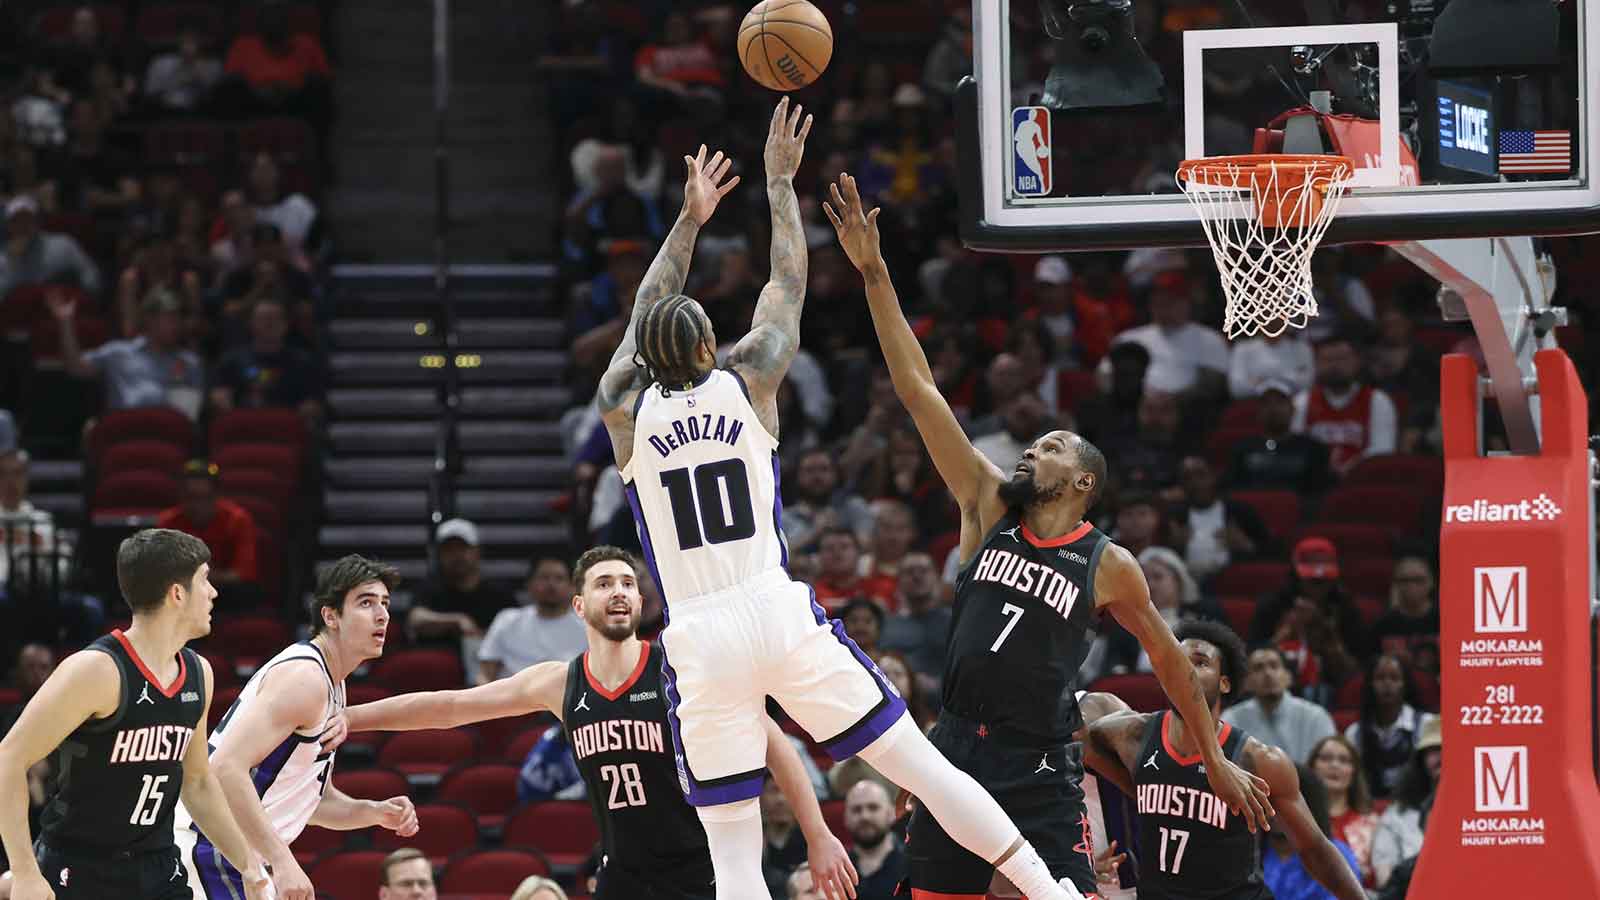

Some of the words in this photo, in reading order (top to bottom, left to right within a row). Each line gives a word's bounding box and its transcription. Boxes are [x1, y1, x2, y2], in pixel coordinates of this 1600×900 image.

[1018, 175, 1037, 190] NBA
[659, 457, 756, 551] 10
[1446, 499, 1531, 523] reliant
[973, 549, 1080, 620] HOUSTON
[990, 602, 1025, 653] 7
[1460, 639, 1543, 653] MOKARAM
[1460, 658, 1495, 667] INJURY
[1496, 656, 1543, 667] LAWYERS
[1485, 684, 1516, 705] 281
[1460, 704, 1544, 726] 222-2222
[110, 724, 194, 763] HOUSTO
[572, 719, 665, 761] HOUSTON
[129, 774, 169, 826] 15
[600, 762, 648, 810] 28
[1136, 783, 1228, 831] HOUSTON
[1462, 817, 1545, 832] MOKARAM
[1159, 826, 1191, 875] 17
[1462, 837, 1497, 847] INJURY
[1498, 835, 1545, 846] LAWYERS
